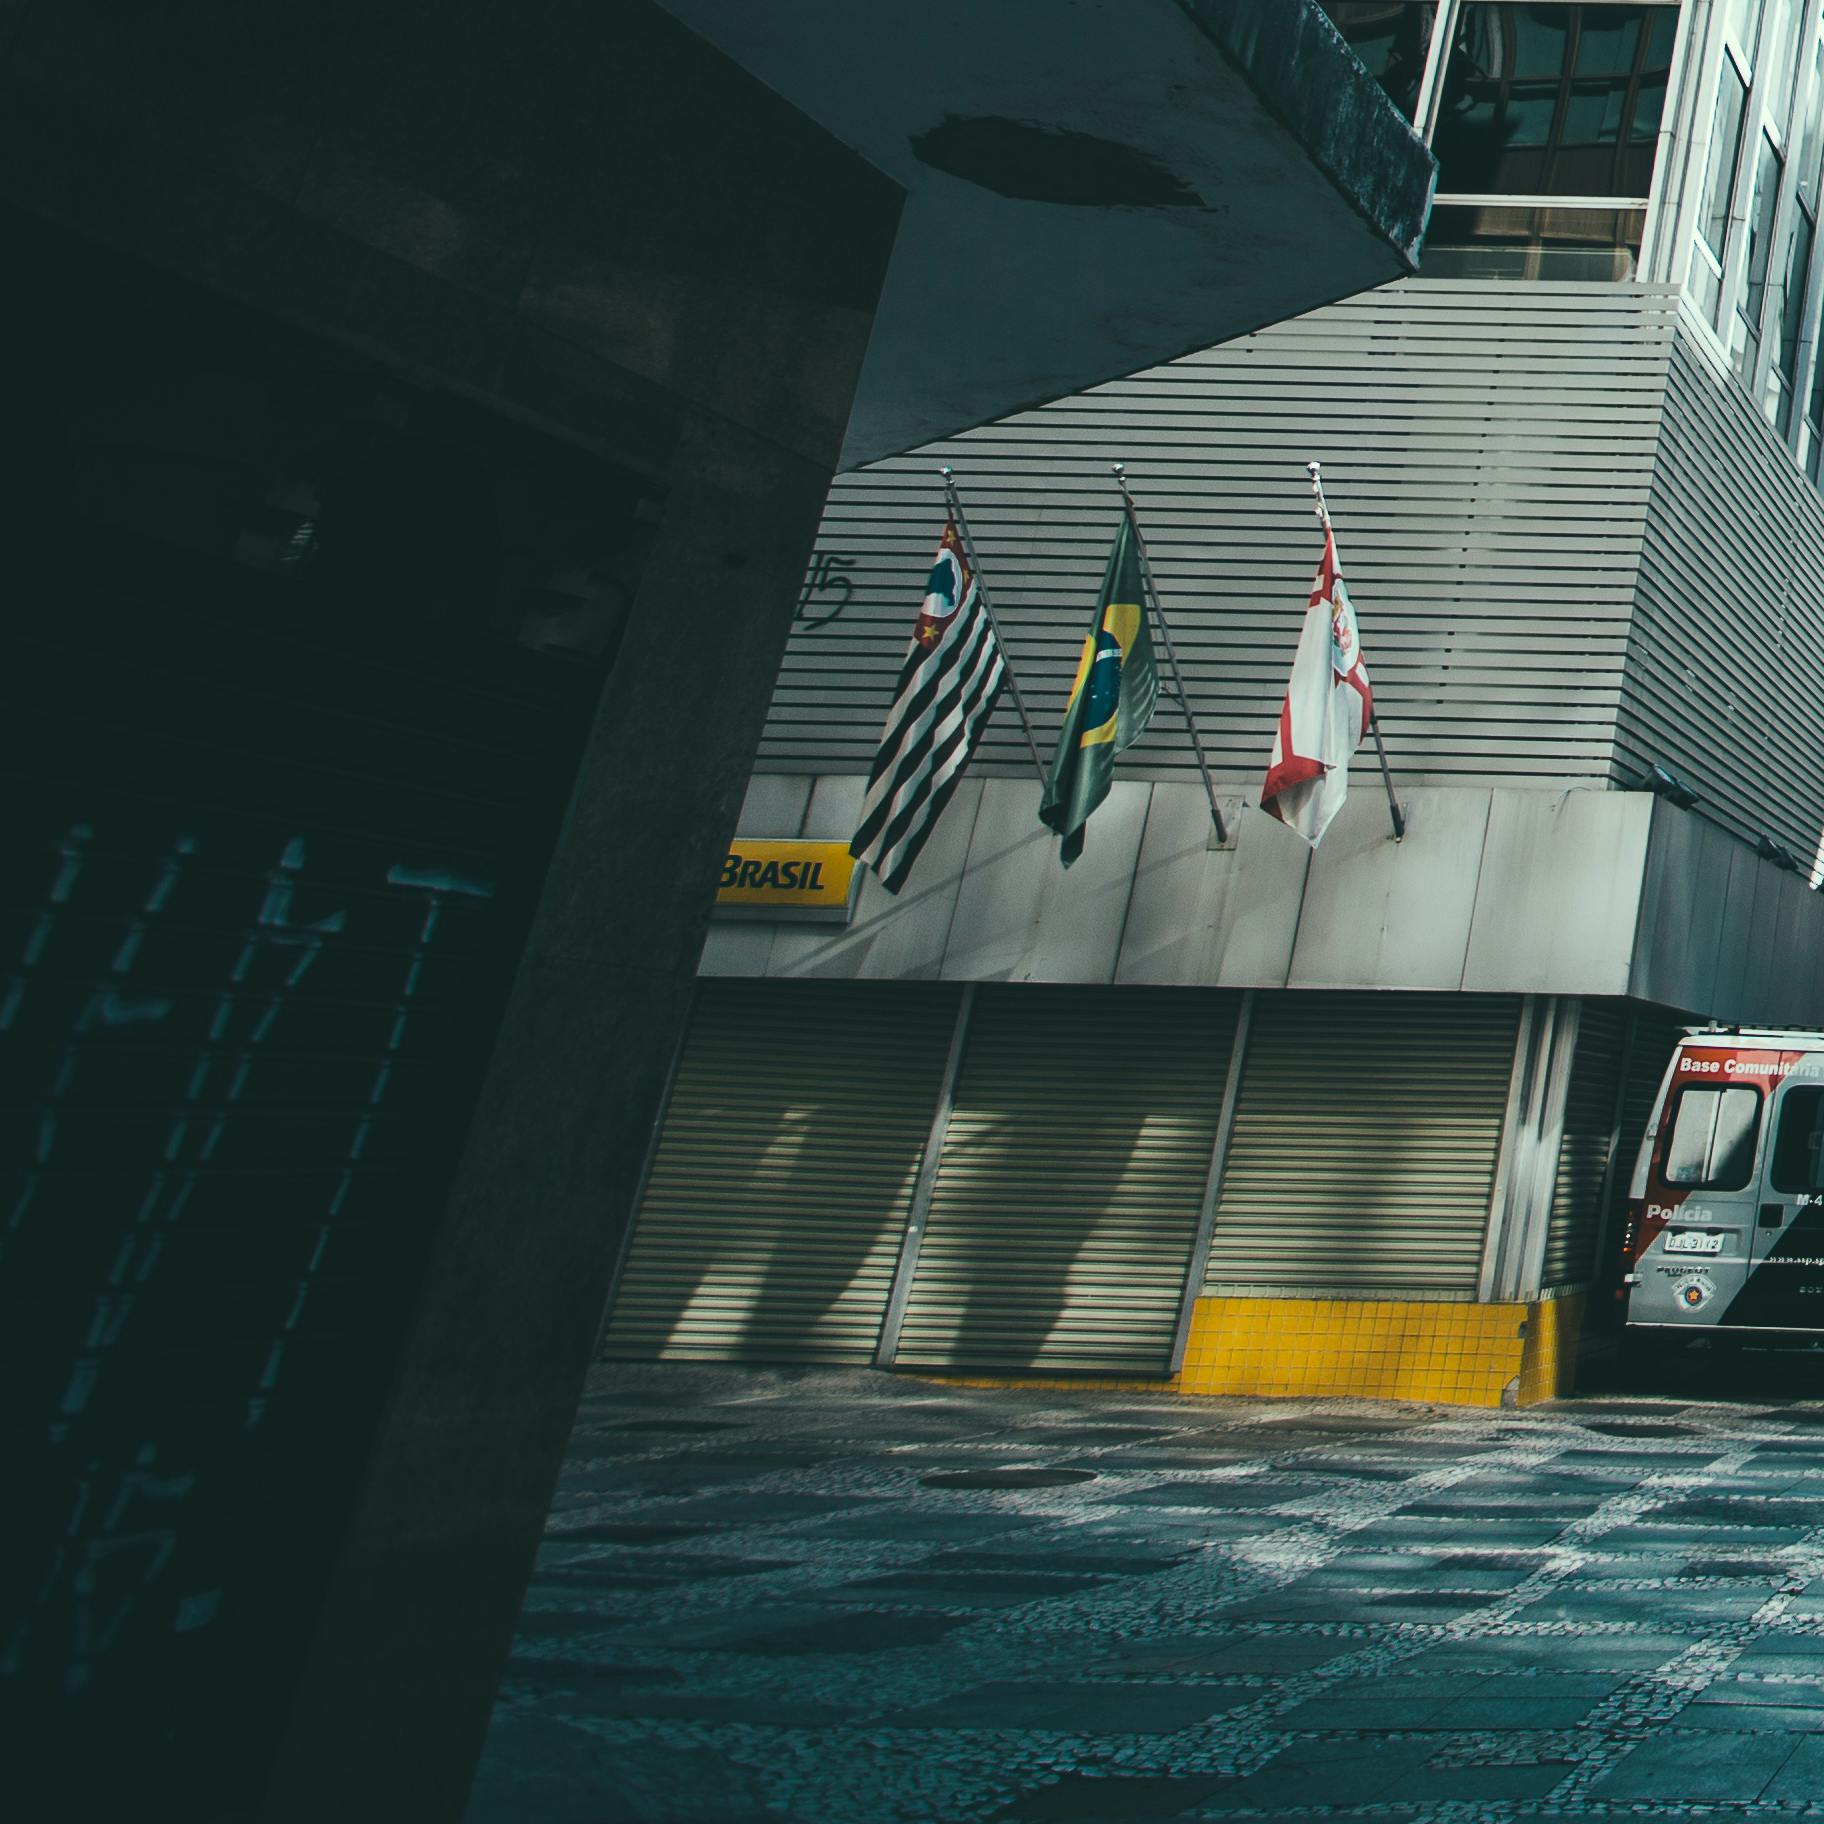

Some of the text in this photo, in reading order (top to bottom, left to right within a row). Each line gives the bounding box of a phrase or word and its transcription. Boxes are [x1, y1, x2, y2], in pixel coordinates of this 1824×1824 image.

[720, 854, 824, 890] BRASIL
[1679, 1057, 1720, 1074] Base
[1646, 1203, 1713, 1222] Polícia
